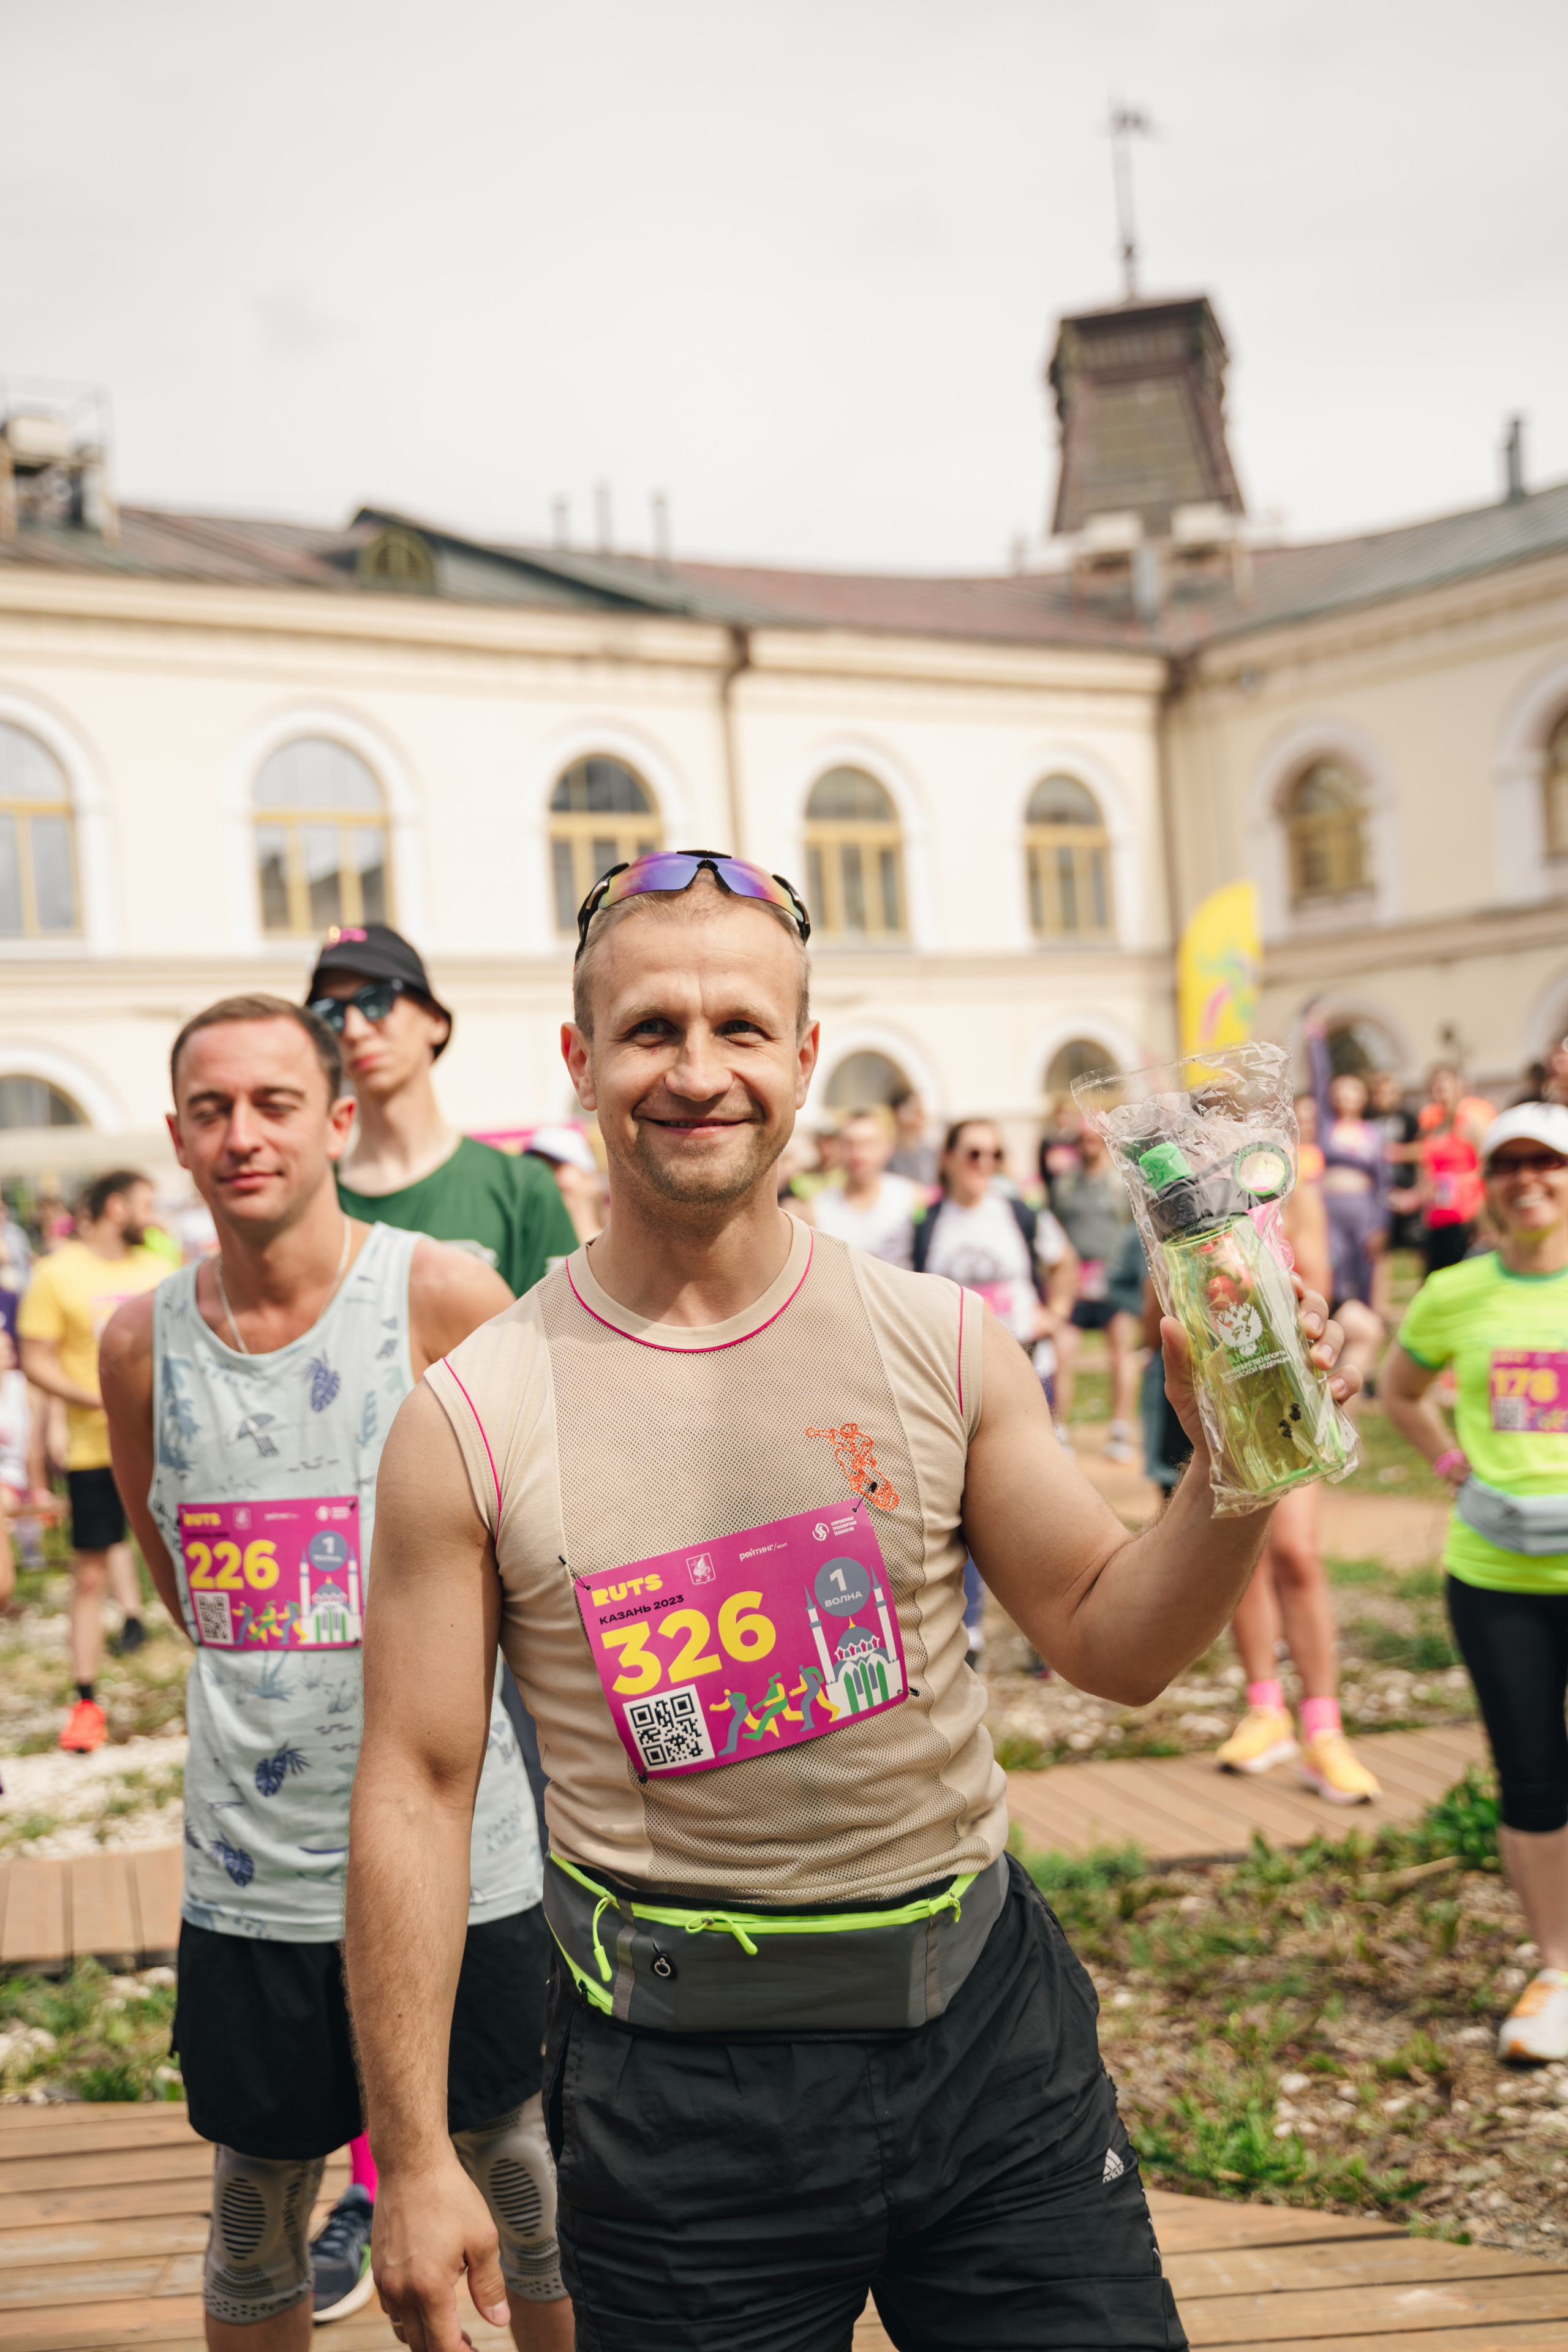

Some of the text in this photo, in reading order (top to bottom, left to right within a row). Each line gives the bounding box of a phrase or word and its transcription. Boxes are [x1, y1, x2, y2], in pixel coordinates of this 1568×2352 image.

[1264, 1350, 1286, 1360] СПОРТА
[322, 1536, 335, 1555] 1
[186, 1539, 280, 1590] 226
[591, 1574, 663, 1607] RUTS
[829, 1568, 847, 1592] 1
[599, 1594, 685, 1625] КАЗАНЬ 2023
[824, 1591, 863, 1608] ВОЛНА
[601, 1590, 777, 1695] 326
